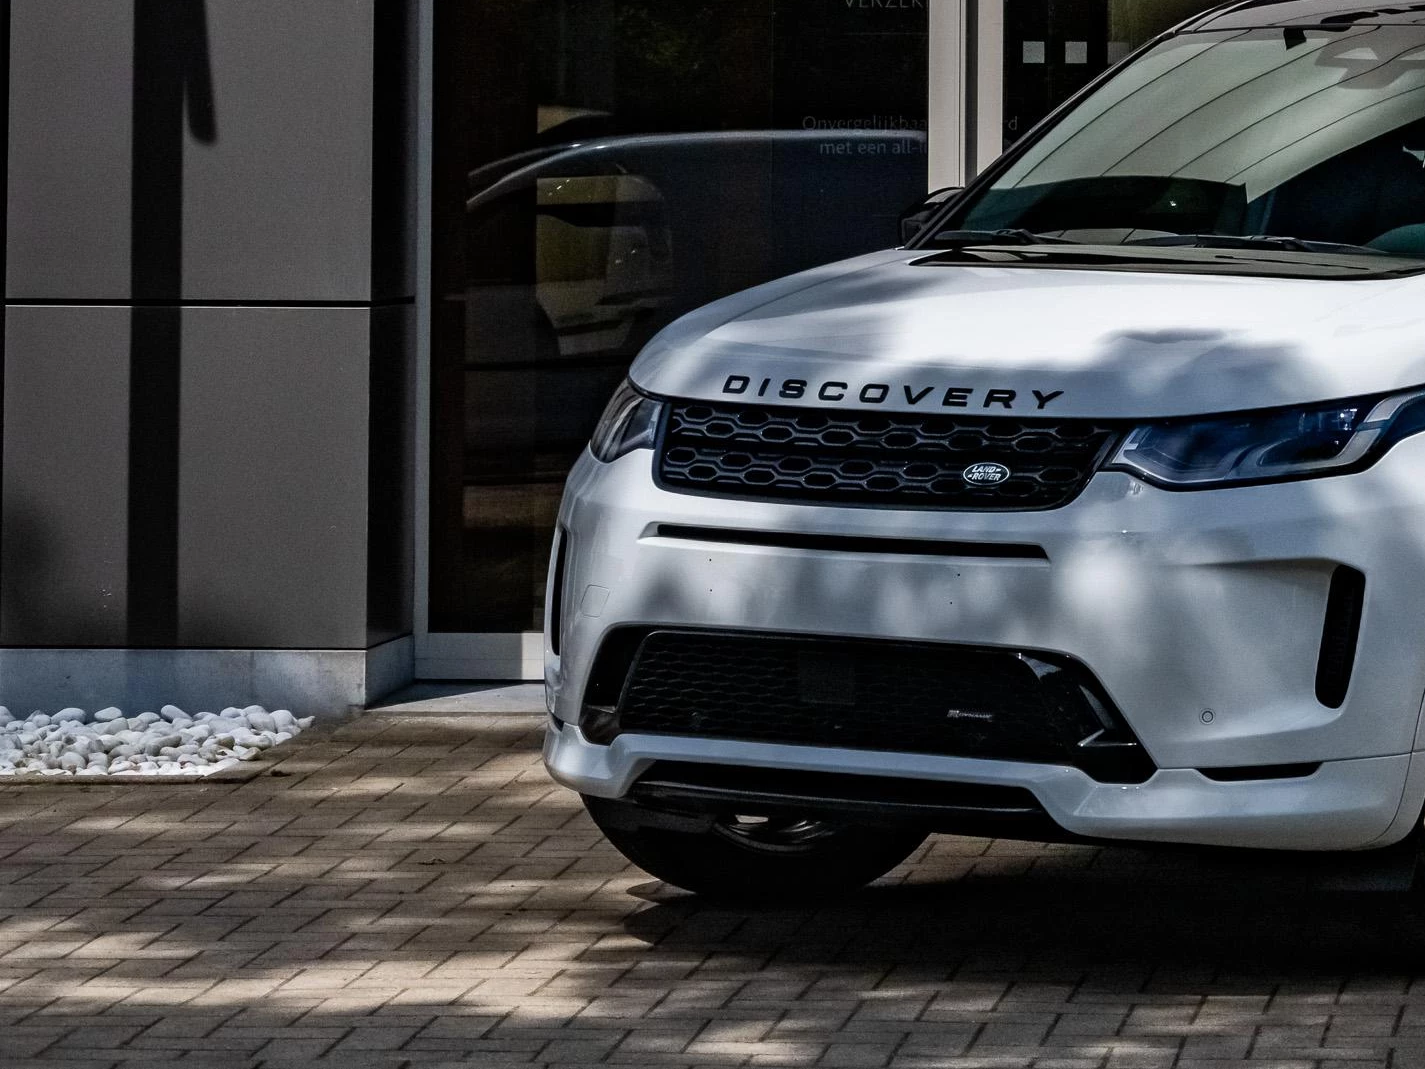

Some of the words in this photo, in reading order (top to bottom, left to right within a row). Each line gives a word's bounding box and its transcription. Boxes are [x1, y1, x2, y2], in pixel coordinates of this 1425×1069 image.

[819, 140, 853, 155] met
[857, 142, 887, 155] een
[722, 374, 1065, 410] DISCOVERY
[971, 472, 1002, 481] ROVER
